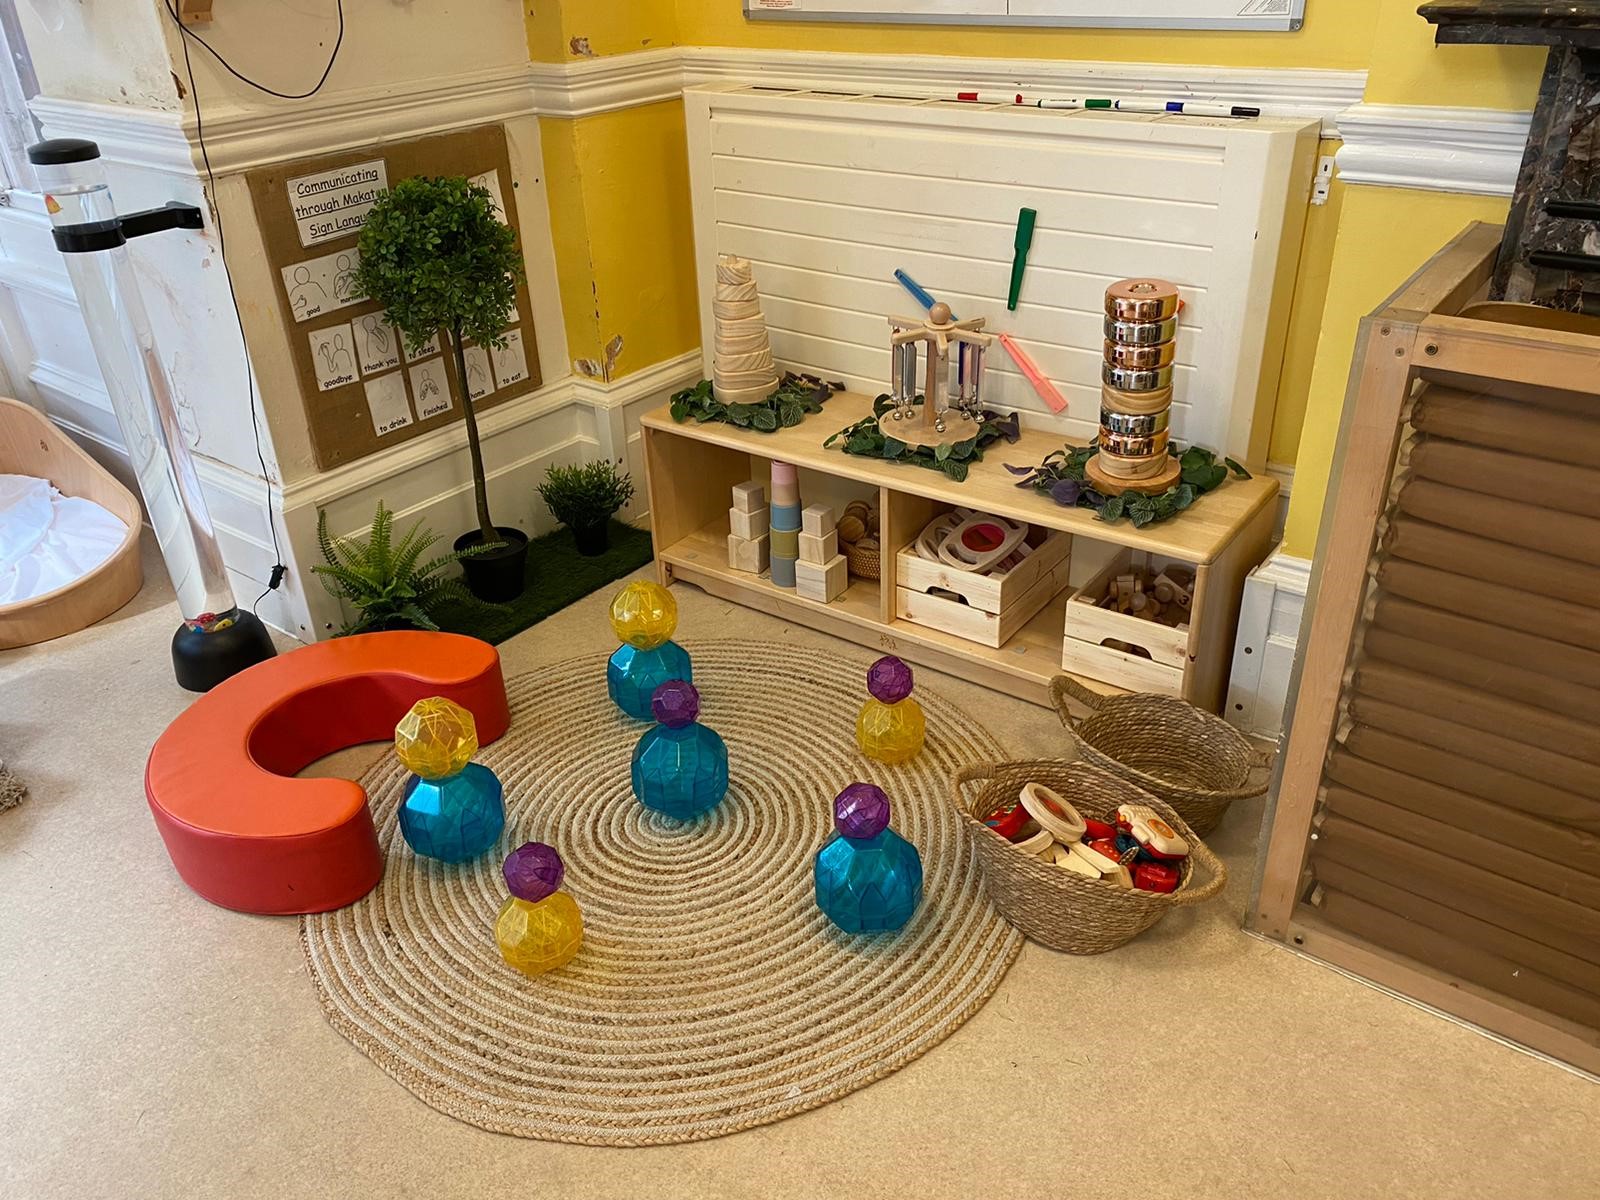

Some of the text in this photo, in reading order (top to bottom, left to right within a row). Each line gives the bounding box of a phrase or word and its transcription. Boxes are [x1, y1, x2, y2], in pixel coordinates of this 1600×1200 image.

[296, 169, 379, 195] Communicating
[296, 187, 388, 218] through Makat
[309, 222, 333, 236] Sign
[306, 305, 321, 317] good
[418, 345, 436, 357] sleep
[364, 357, 398, 373] thank you
[323, 374, 353, 389] goodbye
[511, 372, 521, 381] eat
[423, 402, 449, 417] finished
[379, 416, 408, 434] to drink
